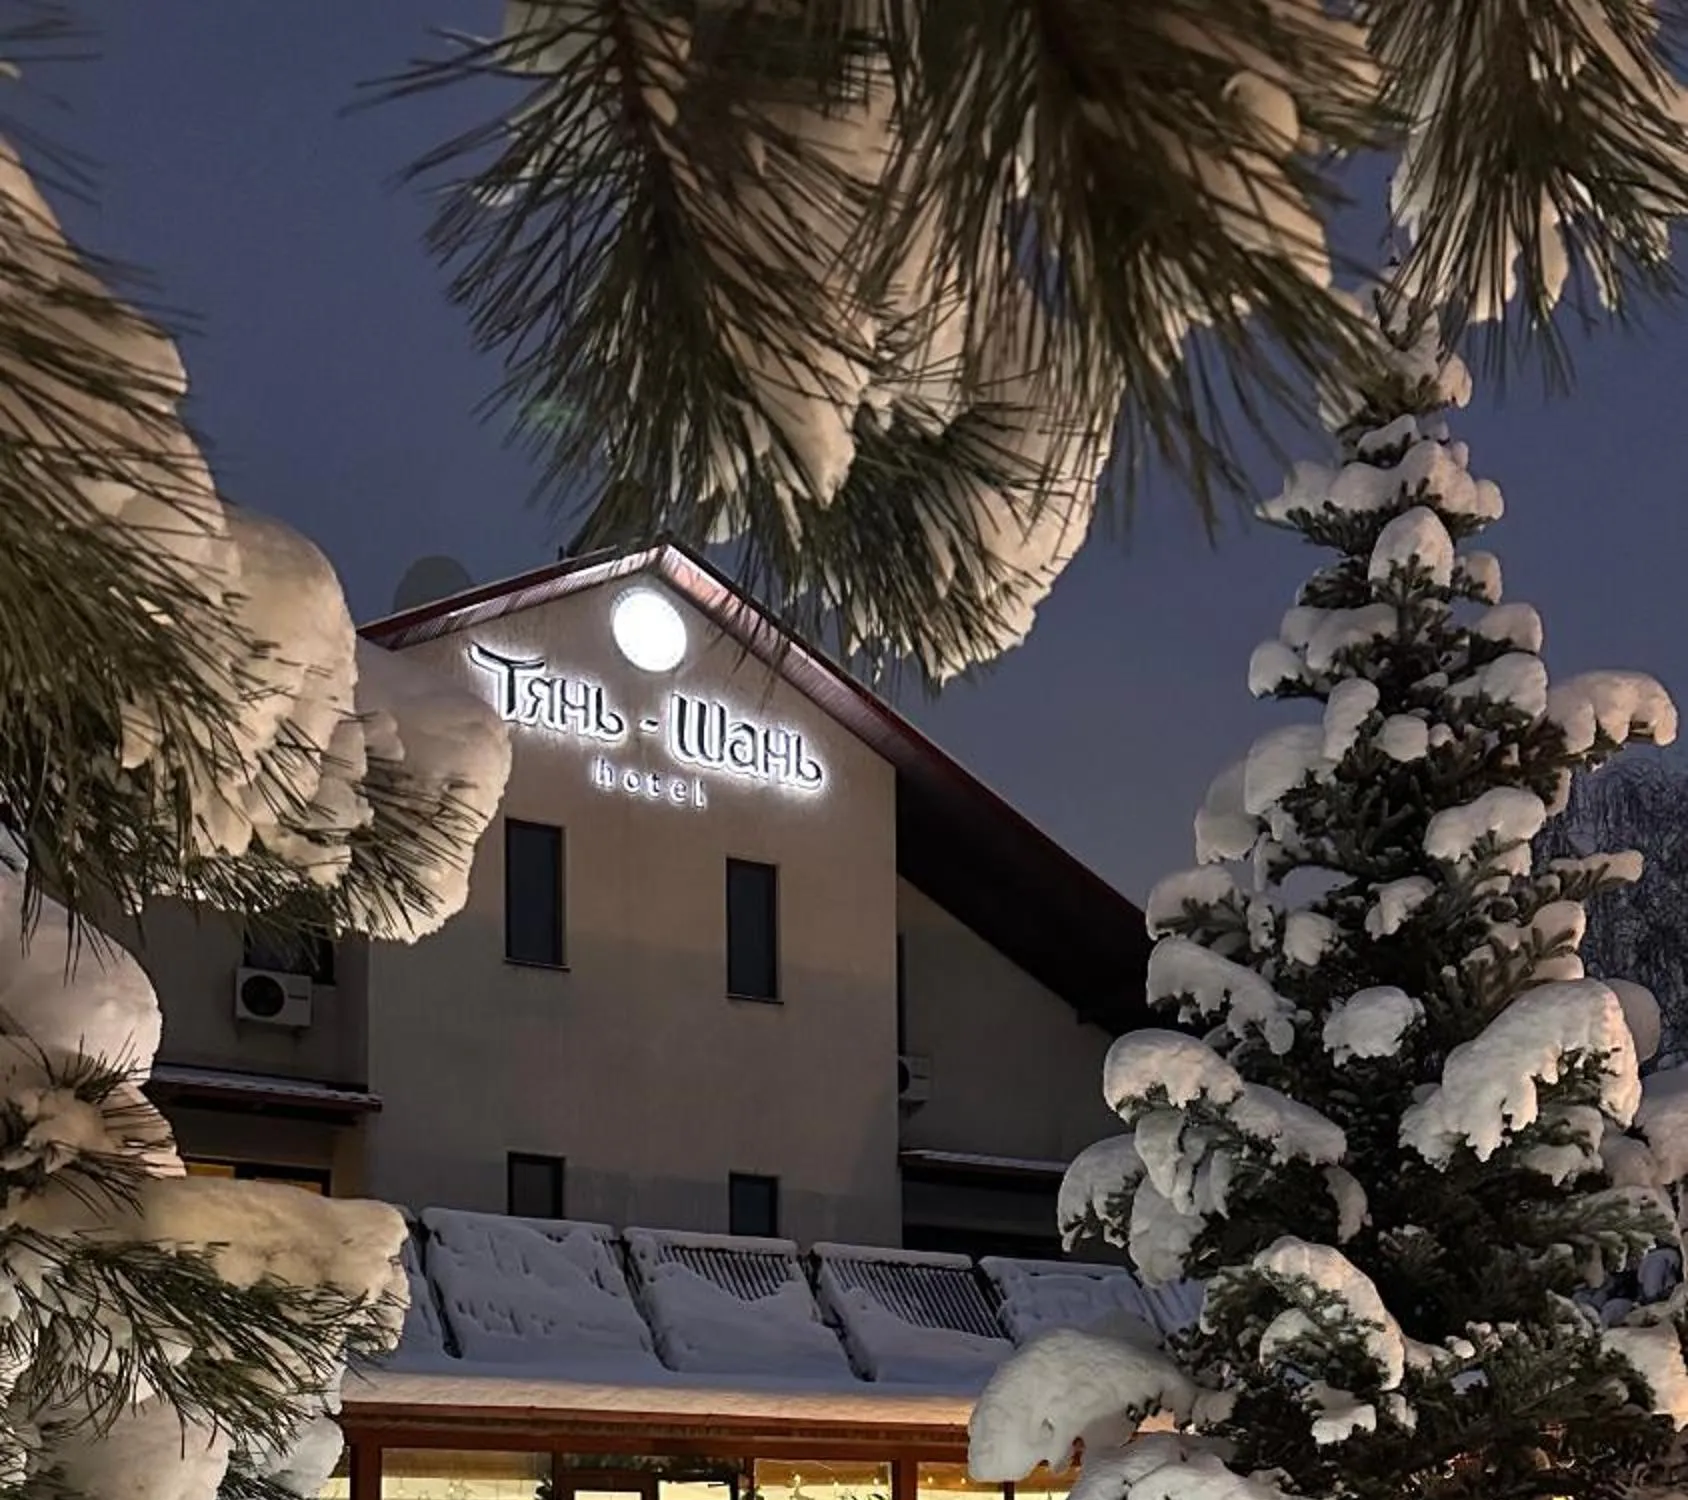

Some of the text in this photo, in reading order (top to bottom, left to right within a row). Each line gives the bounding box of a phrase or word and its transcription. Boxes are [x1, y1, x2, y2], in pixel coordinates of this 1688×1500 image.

[468, 642, 625, 742] Тянь
[669, 692, 825, 792] Шань
[593, 758, 707, 807] hotel
